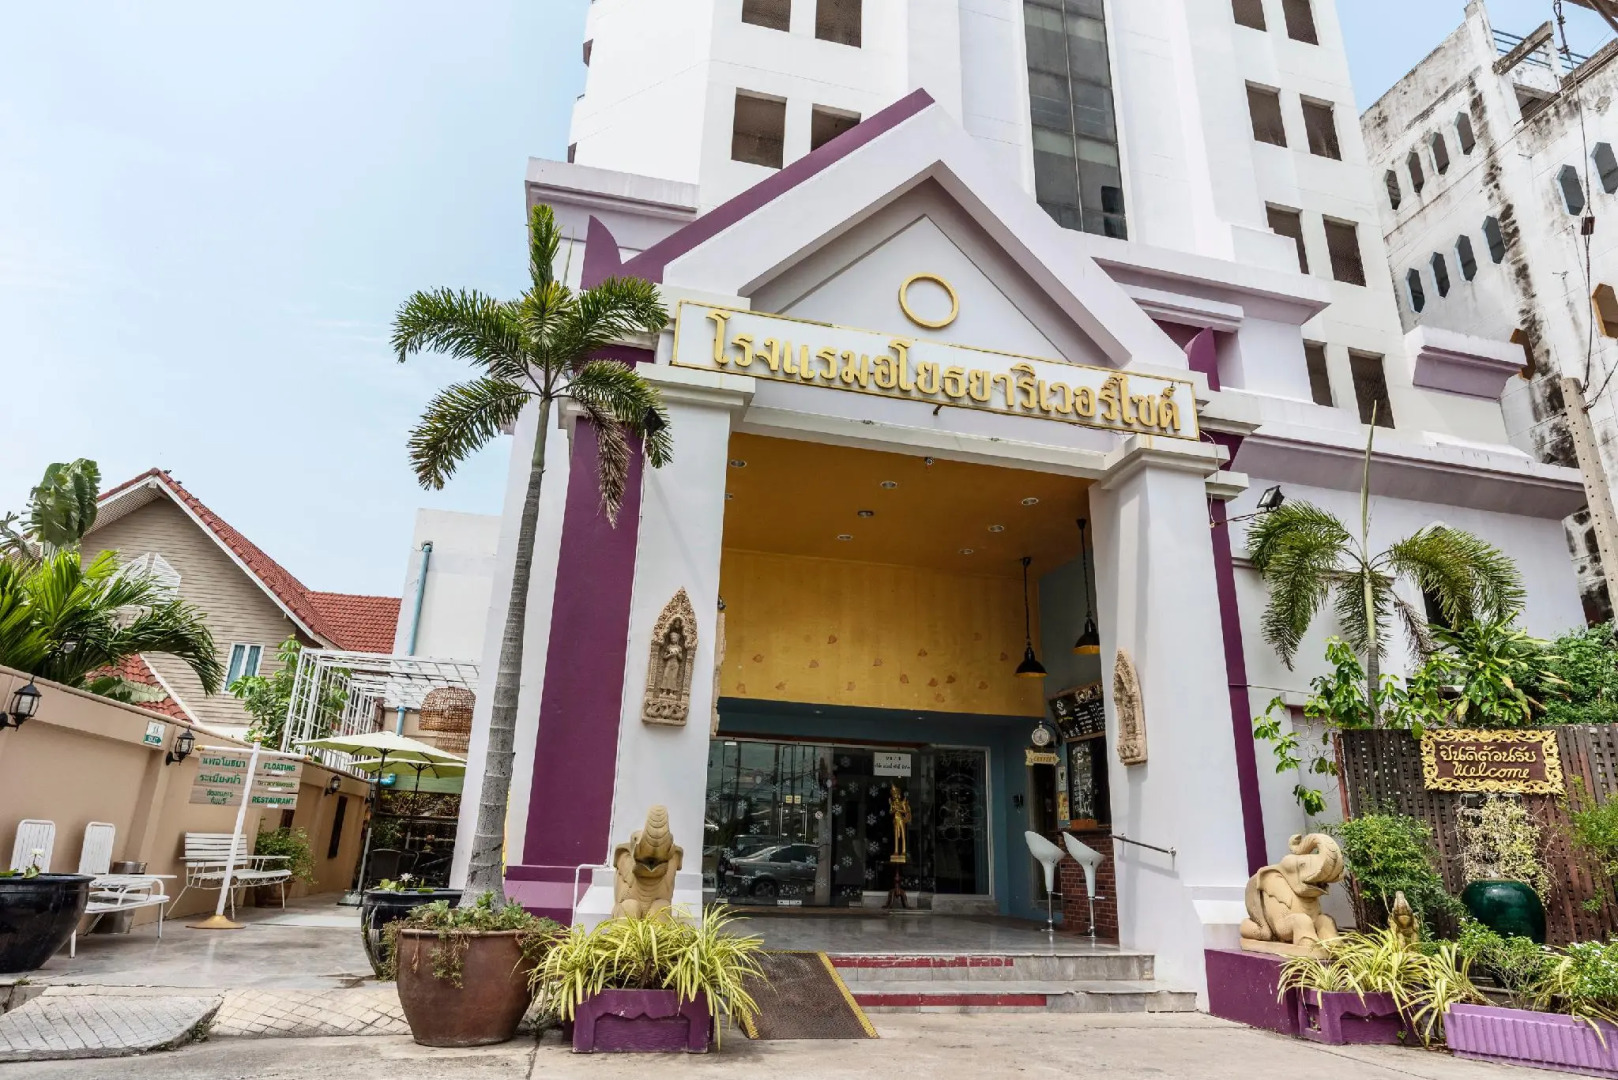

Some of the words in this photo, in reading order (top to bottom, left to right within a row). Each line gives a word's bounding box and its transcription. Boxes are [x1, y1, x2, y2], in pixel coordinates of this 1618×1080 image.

[1439, 745, 1537, 763] ยินดีต้อนรับ
[263, 762, 296, 772] FLOATING
[1452, 761, 1530, 779] Welcome
[251, 796, 296, 805] RESTAURANT
